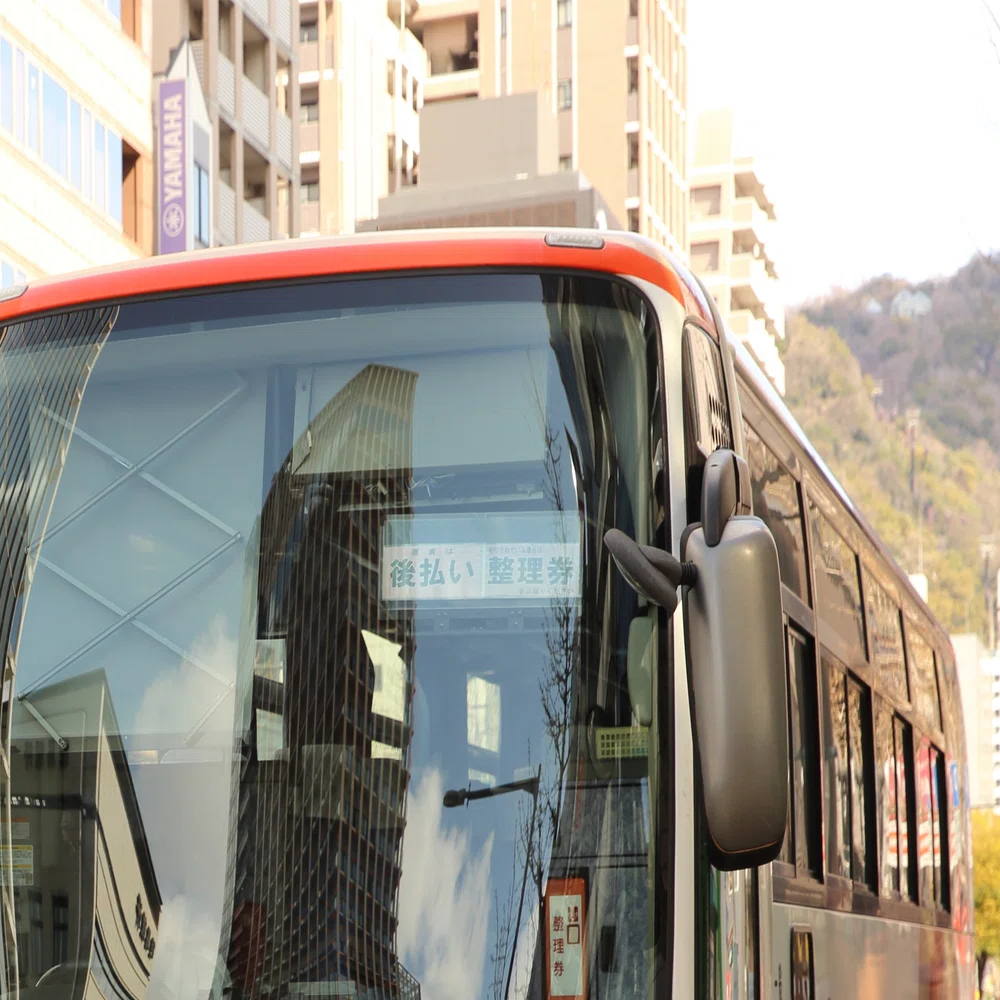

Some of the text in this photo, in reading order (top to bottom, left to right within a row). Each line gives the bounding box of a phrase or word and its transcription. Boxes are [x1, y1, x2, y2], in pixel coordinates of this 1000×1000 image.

[163, 93, 183, 203] YAMAHA
[389, 556, 575, 588] 後払い 整理券
[552, 915, 565, 977] 整理券
